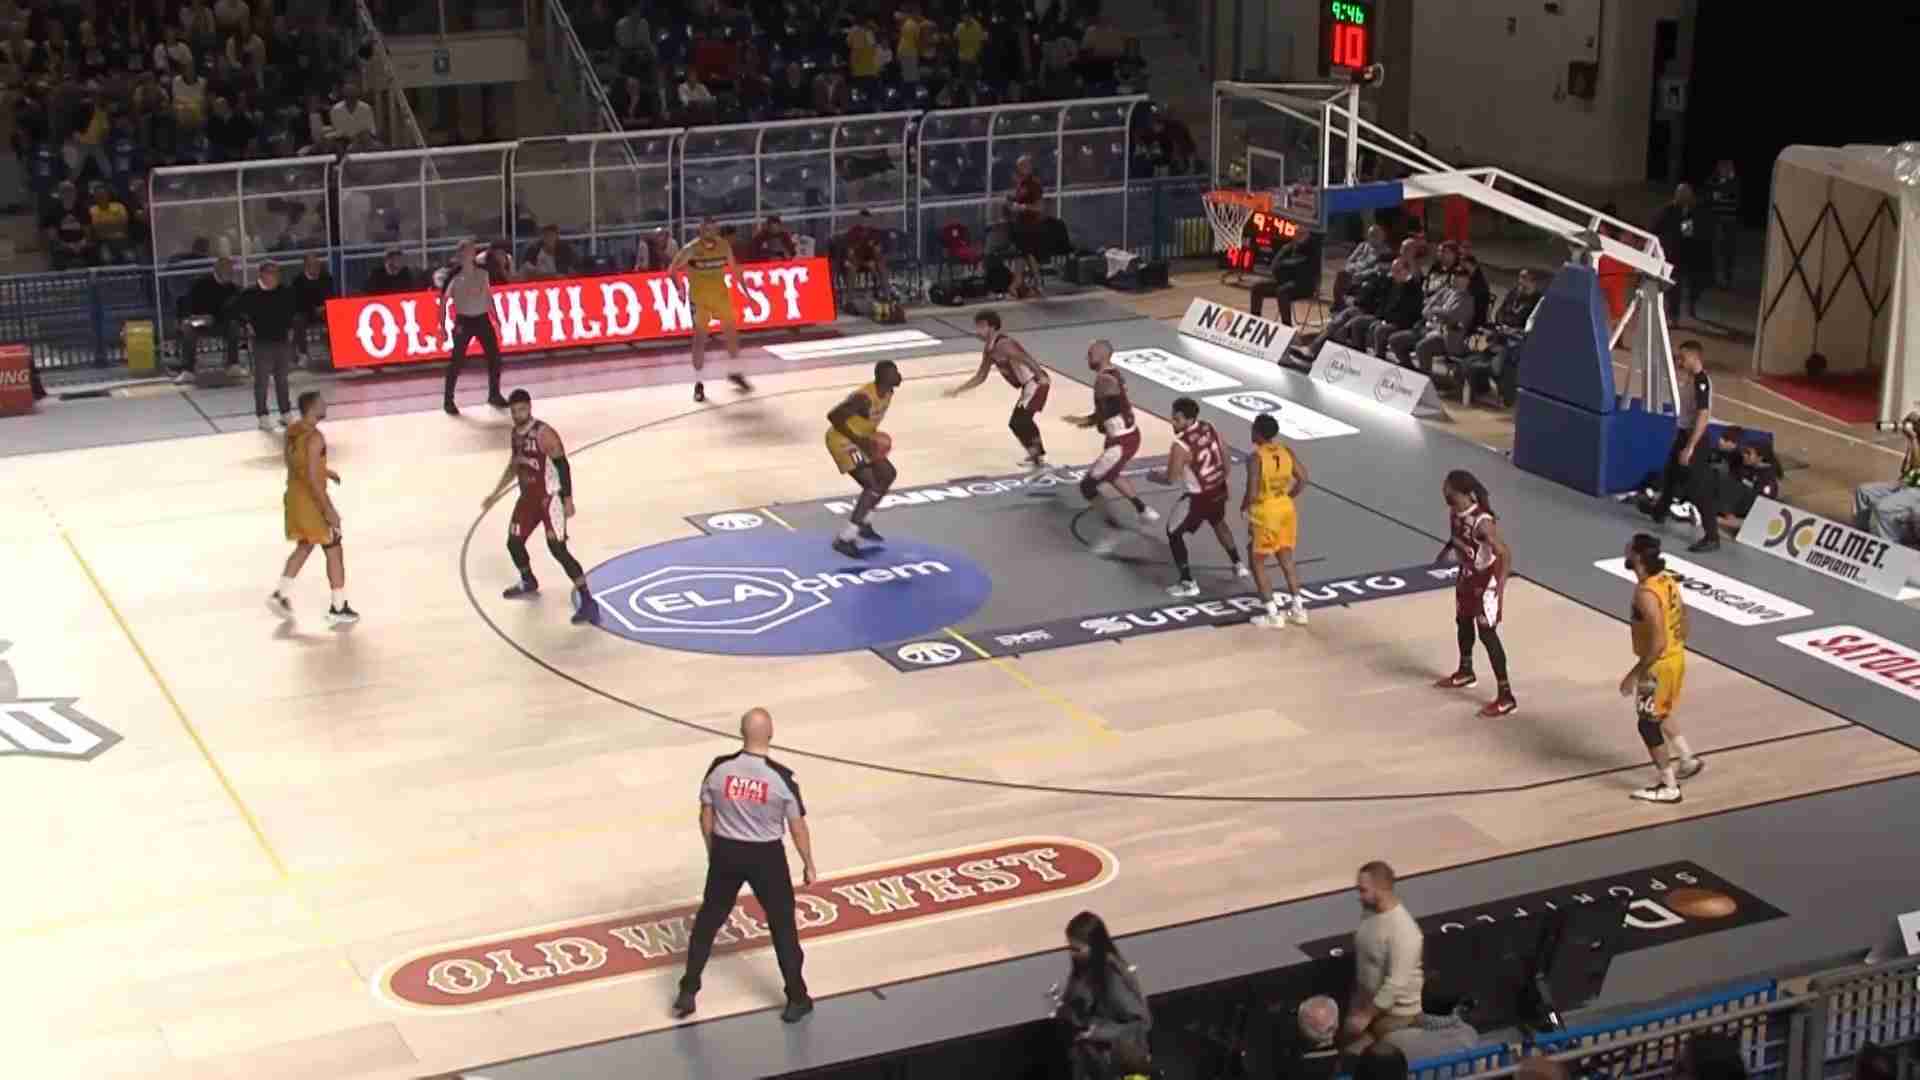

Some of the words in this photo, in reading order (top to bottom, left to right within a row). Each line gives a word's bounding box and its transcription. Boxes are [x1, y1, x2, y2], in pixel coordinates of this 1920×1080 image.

[1332, 2, 1365, 24] 9:46
[1334, 24, 1364, 66] 10
[1253, 213, 1296, 236] 9:46
[492, 281, 643, 346] WILD
[648, 266, 808, 332] WST
[1198, 304, 1279, 349] NOLFIN
[1199, 440, 1223, 477] 21
[644, 582, 781, 613] ELA
[791, 560, 951, 593] chem
[1805, 551, 1860, 580] IMPIANTI
[1807, 634, 1920, 691] SATOLL
[426, 937, 608, 995] OLD
[834, 847, 1067, 915] WEST
